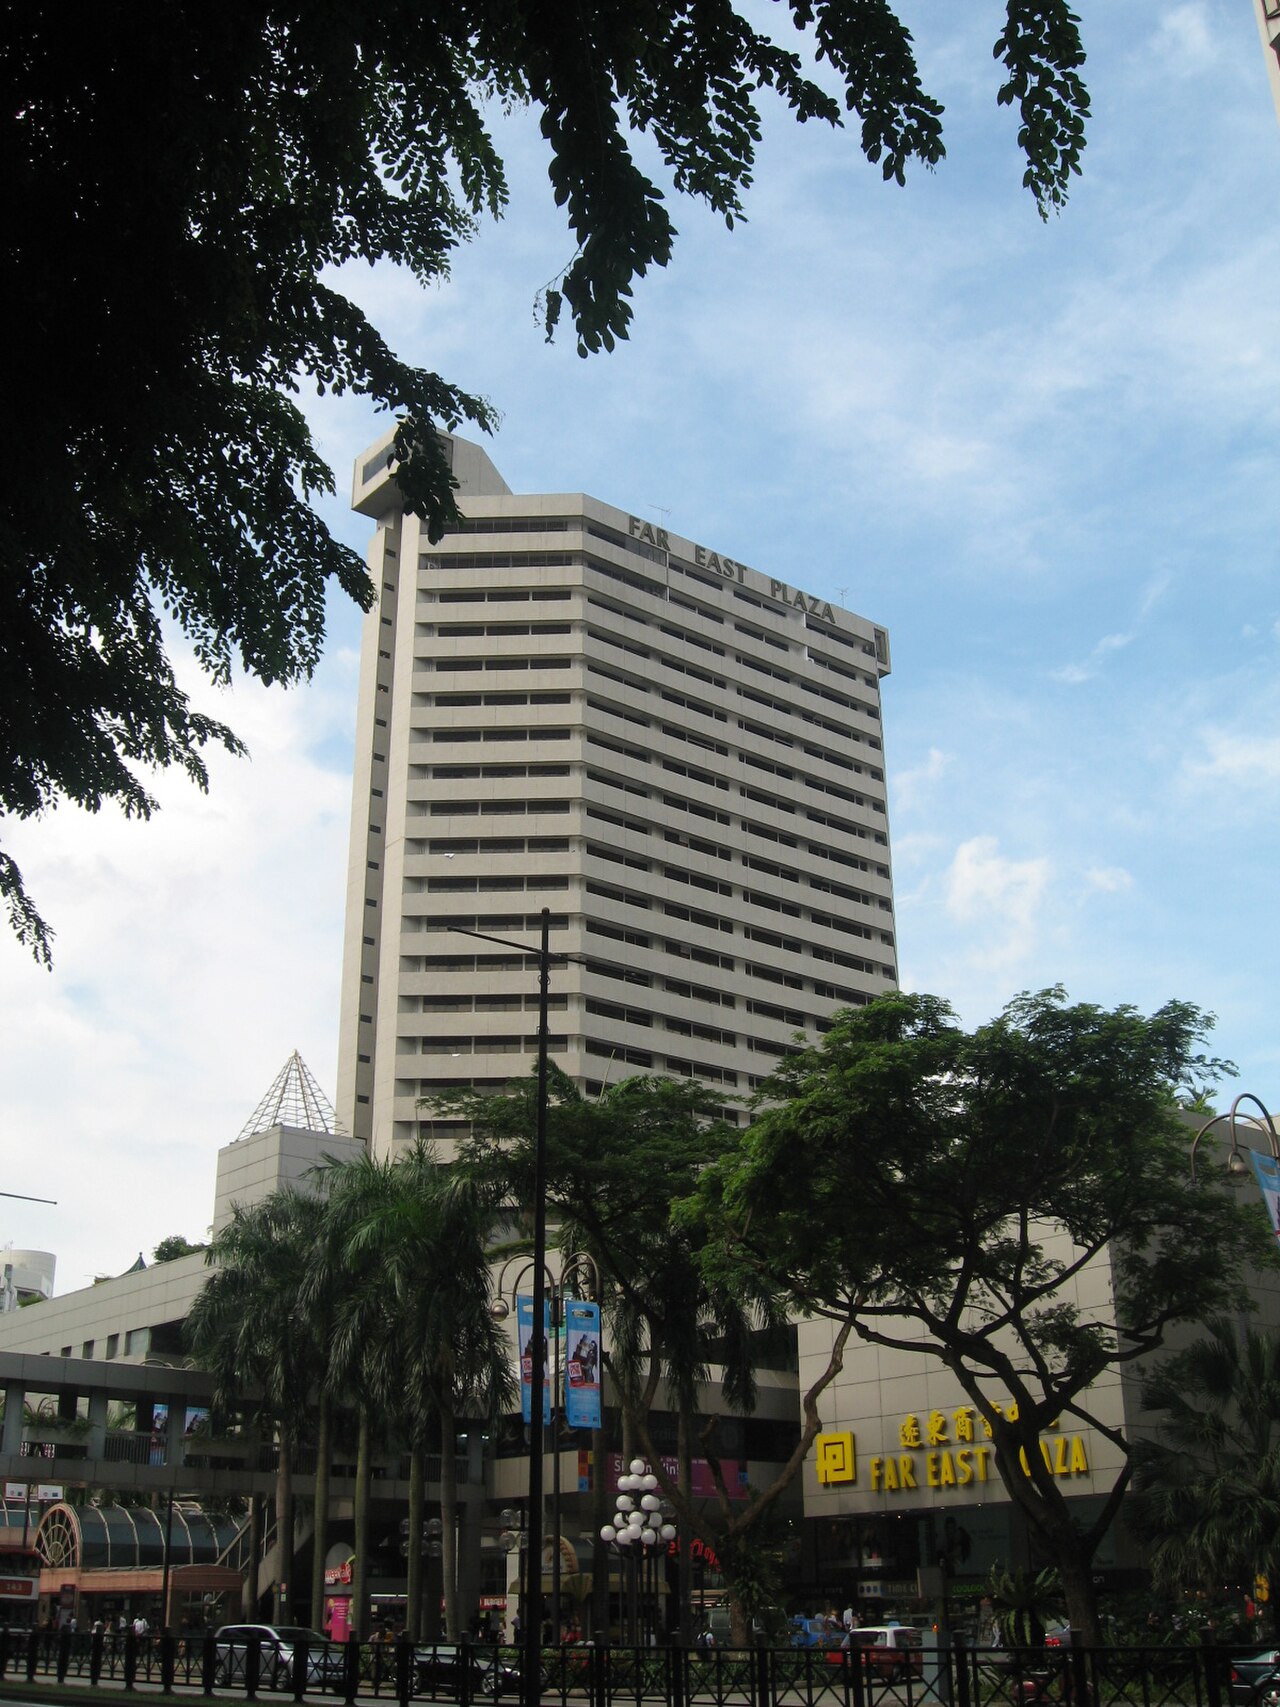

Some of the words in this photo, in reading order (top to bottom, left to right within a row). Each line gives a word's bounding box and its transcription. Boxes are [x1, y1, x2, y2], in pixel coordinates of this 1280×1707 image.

[629, 516, 671, 551] FAR
[694, 545, 747, 584] EAST
[771, 580, 836, 624] PLAZA
[871, 1455, 917, 1490] FAR
[928, 1447, 990, 1486] EAST
